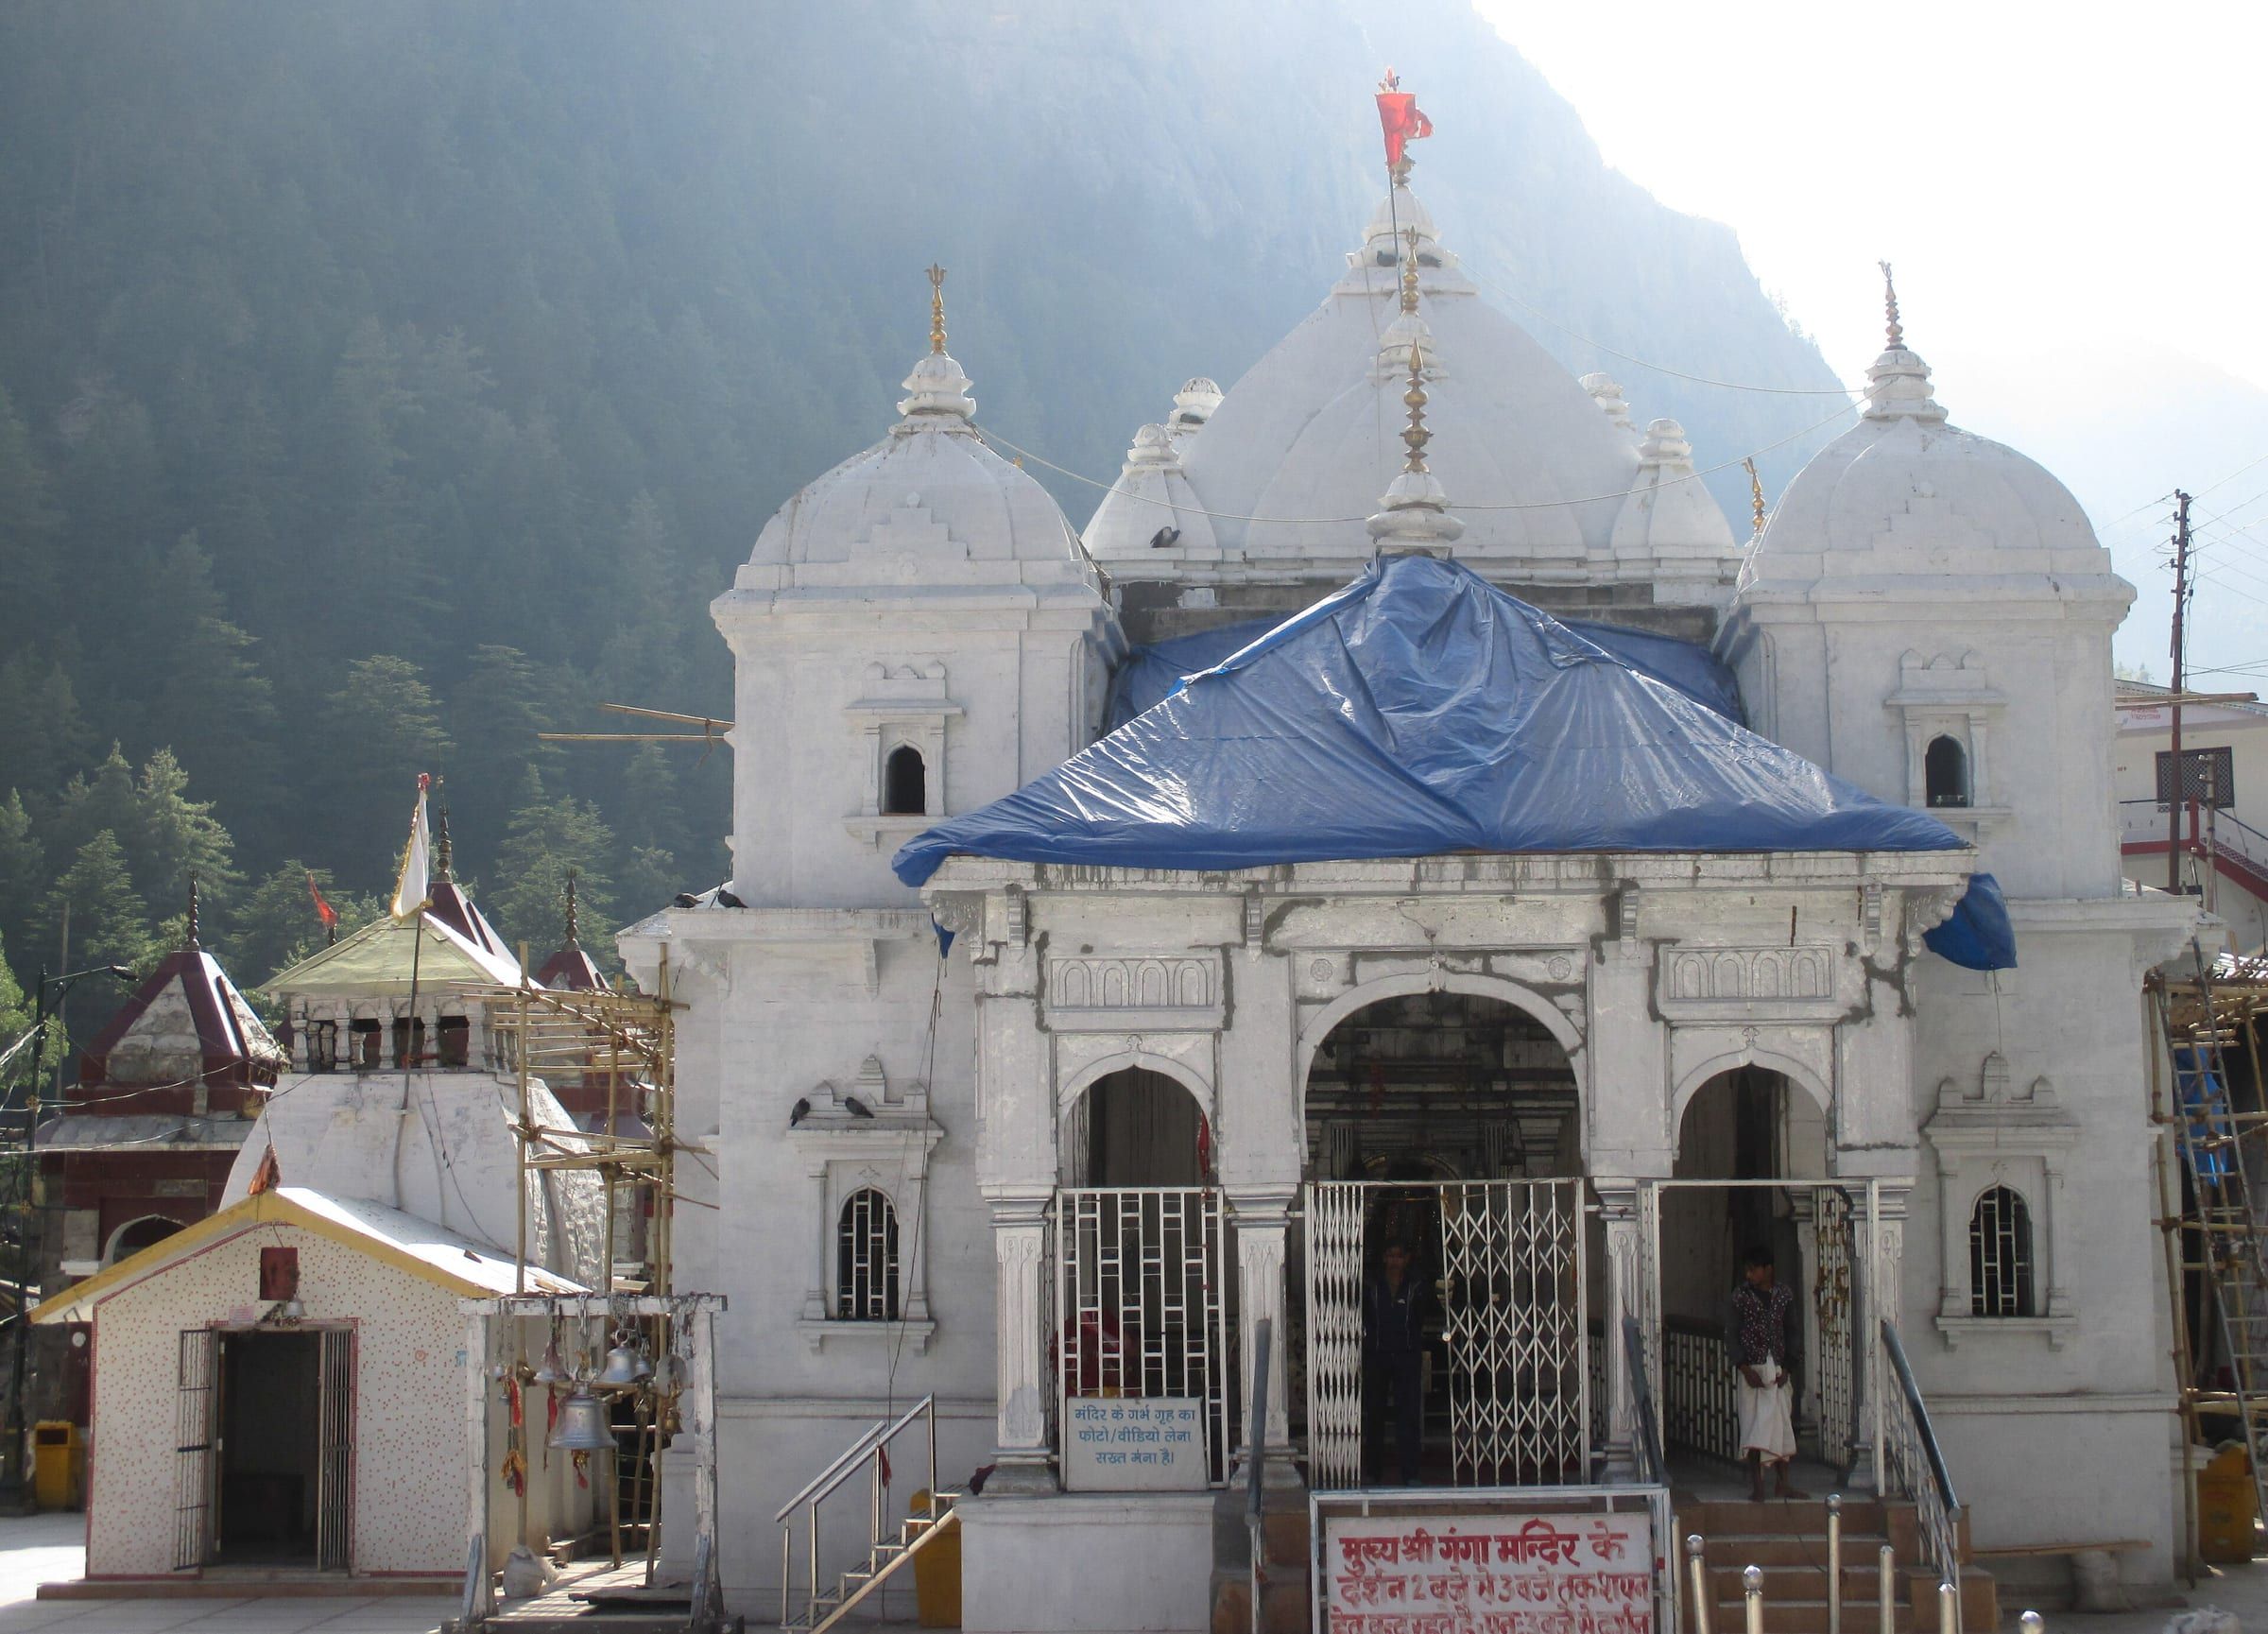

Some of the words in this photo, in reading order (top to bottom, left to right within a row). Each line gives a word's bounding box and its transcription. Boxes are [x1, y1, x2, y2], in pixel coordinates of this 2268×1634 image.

[1074, 1404, 1108, 1421] मंदिर
[1110, 1403, 1125, 1421] के
[1127, 1403, 1150, 1421] गर्भ
[1155, 1409, 1176, 1425] गृह
[1178, 1409, 1196, 1421] का
[1163, 1426, 1192, 1443] लेना
[1095, 1452, 1126, 1465] सख्त
[1338, 1536, 1400, 1577] मुख्य
[1400, 1526, 1435, 1565] श्री
[1437, 1525, 1492, 1565] गंगा
[1494, 1518, 1581, 1568] मन्दिर
[1587, 1520, 1628, 1561] के
[1336, 1567, 1408, 1608] दर्शन
[1411, 1574, 1426, 1601] 2
[1427, 1565, 1470, 1602] बजे
[1472, 1565, 1496, 1606] से
[1498, 1574, 1513, 1603] 3
[1514, 1565, 1555, 1603] बजे
[1557, 1574, 1596, 1607] तक
